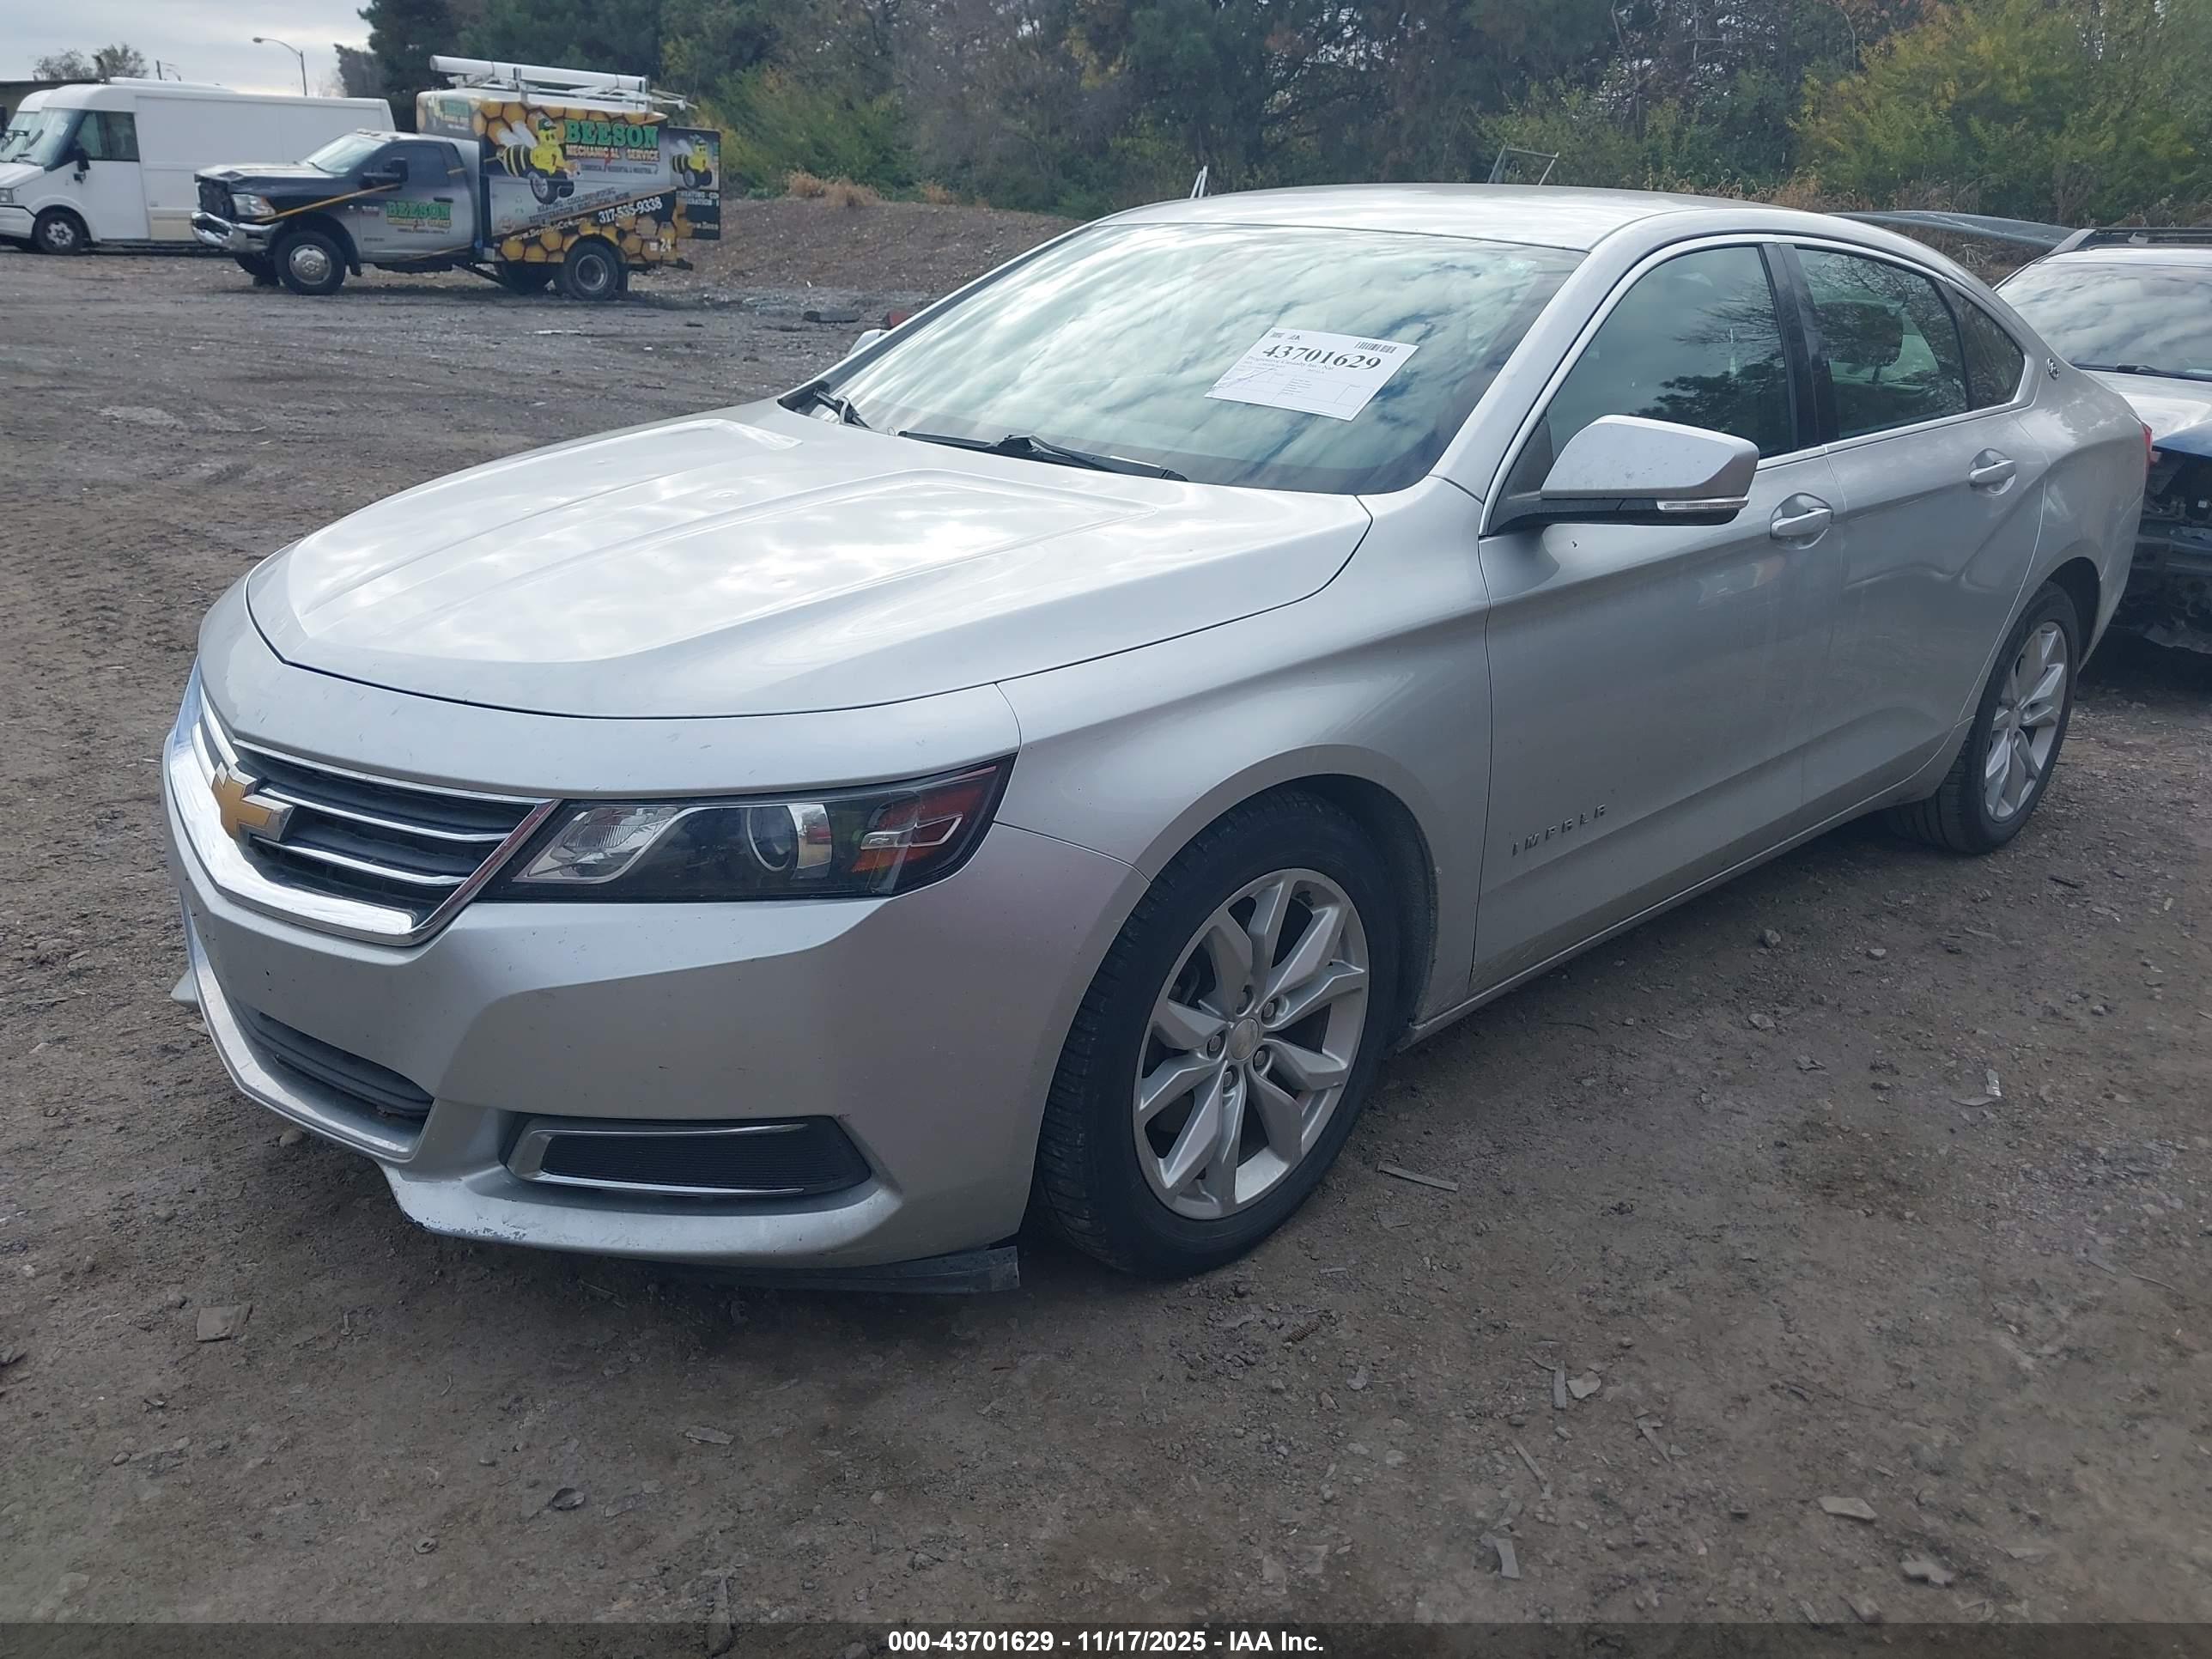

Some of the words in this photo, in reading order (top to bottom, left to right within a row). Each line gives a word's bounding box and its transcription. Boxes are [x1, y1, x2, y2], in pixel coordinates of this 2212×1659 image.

[564, 119, 659, 149] BEESON
[627, 148, 660, 162] SERVICE
[386, 200, 451, 220] BEESON
[599, 196, 663, 224] 317-535-9338
[659, 238, 672, 253] 24
[1262, 343, 1382, 370] 43701629
[1511, 803, 1607, 857] IMPALA
